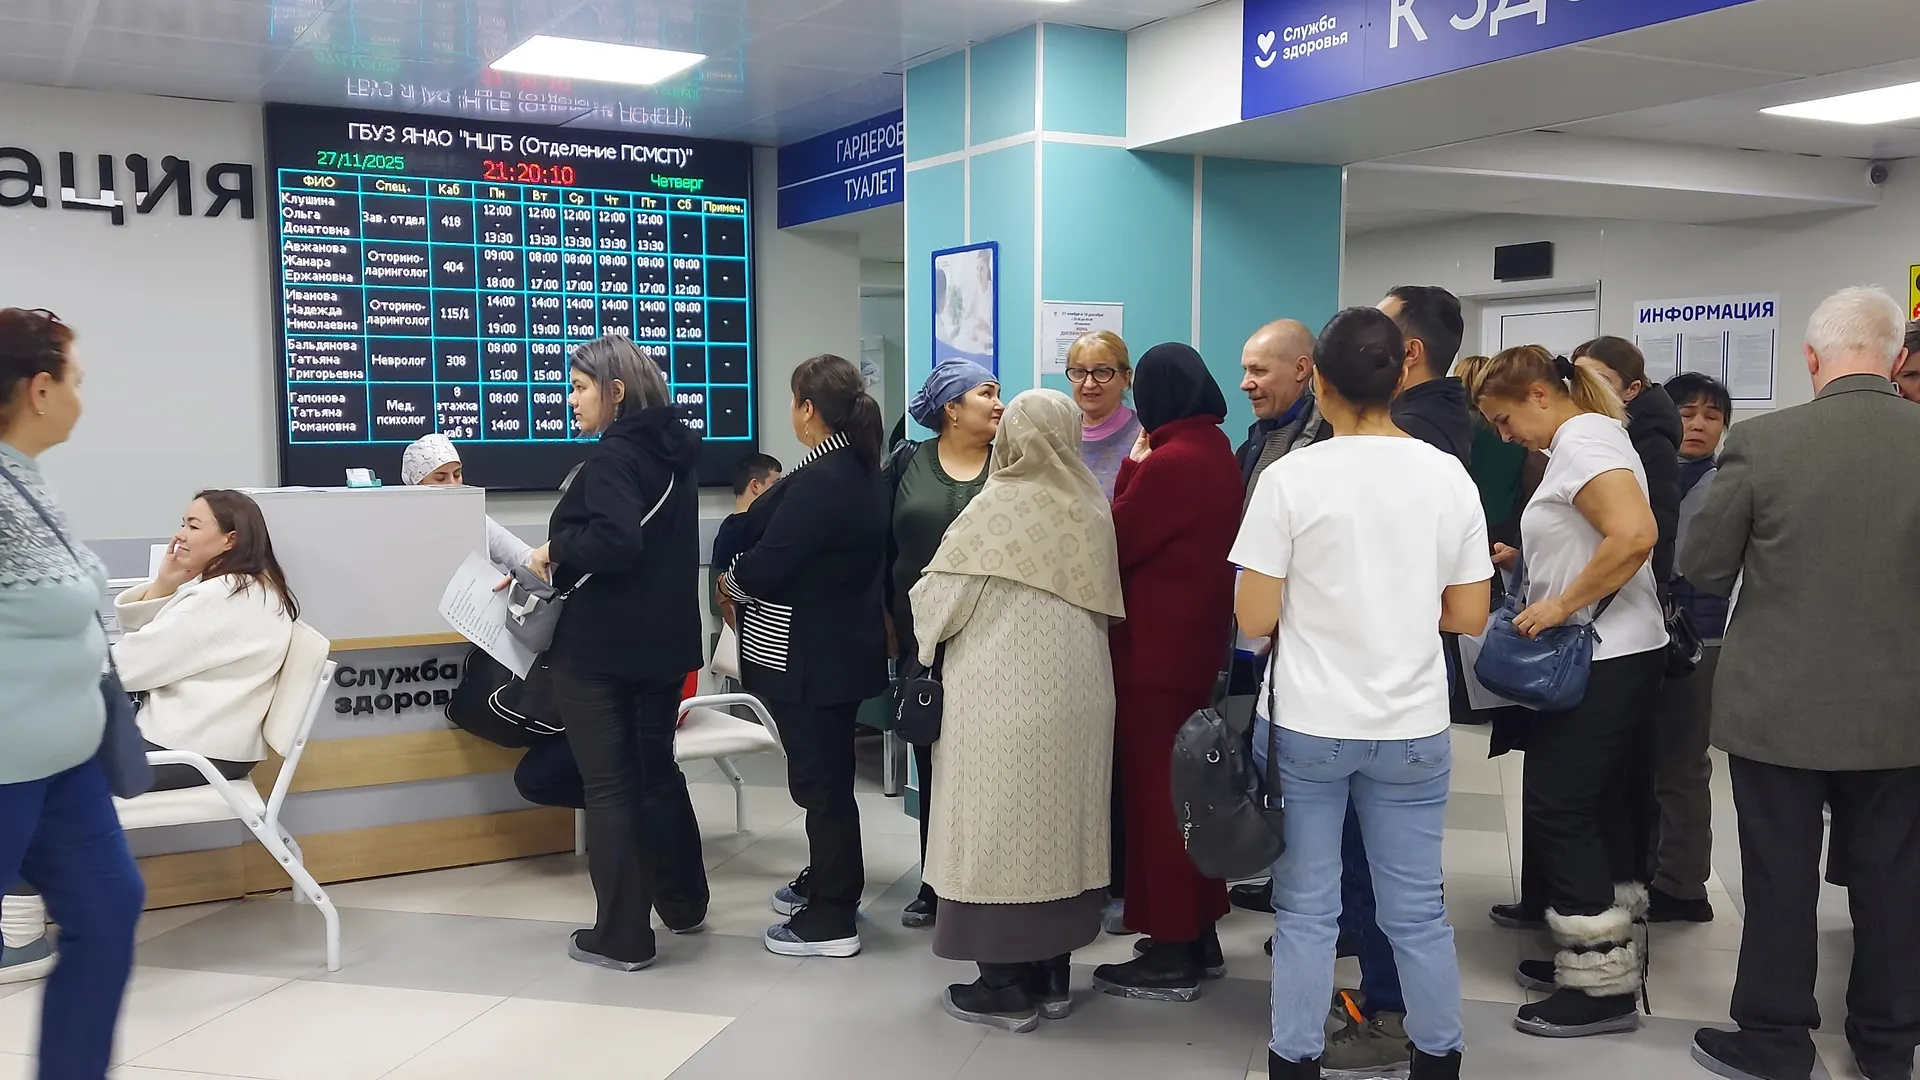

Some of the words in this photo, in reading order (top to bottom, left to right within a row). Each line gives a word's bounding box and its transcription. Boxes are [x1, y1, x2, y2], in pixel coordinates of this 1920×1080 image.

[1283, 14, 1336, 42] Служба
[1282, 31, 1348, 60] здоровья
[348, 122, 396, 143] ГБУЗ
[401, 127, 453, 147] ЯНАО
[459, 128, 514, 152] "НЦГБ
[519, 135, 617, 161] (Отделение
[621, 145, 694, 168] ПСМСП)"
[836, 120, 904, 163] ГАРДЕРОБ
[316, 150, 405, 171] 27/11/2025
[482, 160, 575, 185] 21:20:10
[302, 175, 336, 188] ФИО
[375, 180, 411, 194] Спец.
[650, 173, 704, 192] Четверг
[844, 167, 897, 202] ТУАЛЕТ
[438, 183, 460, 195] Каб
[489, 187, 506, 199] Пн
[281, 192, 336, 207] Клушина
[532, 190, 548, 202] Вт
[569, 193, 584, 205] Ср
[604, 195, 619, 206] Чт
[641, 197, 657, 208] Пт
[677, 199, 692, 210] Сб
[704, 201, 744, 214] Примеч.
[282, 207, 321, 221] Ольга
[483, 204, 513, 217] 12:00
[528, 207, 556, 219] 12:00
[563, 209, 591, 222] 12:00
[390, 215, 426, 226] отдел
[441, 216, 461, 228] 418
[599, 211, 626, 223] 12:00
[637, 213, 664, 226] 12:00
[283, 222, 350, 236] Донатовна
[484, 231, 514, 244] 13:30
[529, 234, 557, 246] 13:30
[564, 236, 592, 248] 13:30
[283, 240, 347, 254] Авжанова
[599, 238, 627, 250] 13:30
[637, 240, 664, 251] 13:30
[282, 254, 331, 268] Жанара
[367, 250, 424, 264] Оторино-
[484, 249, 514, 261] 09:00
[529, 251, 557, 264] 08:00
[564, 253, 592, 266] 08:00
[599, 255, 627, 267] 08:00
[442, 261, 464, 273] 404
[637, 257, 665, 269] 08:00
[673, 258, 700, 270] 08:00
[284, 269, 354, 283] Ержановна
[365, 266, 428, 278] ларинголог
[486, 277, 515, 289] 18:00
[530, 278, 559, 291] 17:00
[565, 280, 593, 292] 17:00
[601, 281, 628, 293] 17:00
[639, 283, 665, 294] 17:00
[285, 289, 338, 302] Иванова
[674, 284, 701, 296] 12:00
[369, 299, 426, 312] Оторино-
[487, 295, 516, 308] 14:00
[531, 296, 559, 309] 14:00
[566, 298, 594, 310] 14:00
[601, 299, 628, 311] 14:00
[639, 301, 666, 313] 14:00
[674, 302, 701, 313] 08:00
[286, 303, 343, 317] Надежда
[440, 307, 470, 321] 115/1
[1639, 301, 1774, 324] ИНФОРМАЦИЯ
[287, 318, 358, 331] Николаевна
[367, 315, 430, 327] ларинголог
[487, 322, 516, 335] 19:00
[532, 323, 560, 336] 19:00
[567, 324, 594, 336] 19:00
[602, 325, 629, 337] 19:00
[640, 326, 666, 338] 19:00
[676, 327, 702, 339] 12:00
[287, 339, 357, 353] Бальдянова
[487, 342, 517, 354] 08:00
[531, 344, 561, 355] 08:00
[288, 353, 340, 366] Татьяна
[371, 354, 427, 368] Невролог
[445, 355, 466, 367] 308
[288, 368, 364, 381] Григорьевна
[489, 369, 518, 381] 15:00
[533, 369, 562, 381] 15:00
[453, 386, 461, 397] 8
[289, 392, 346, 405] Гапонова
[489, 392, 519, 404] 08:00
[533, 392, 562, 404] 08:00
[676, 393, 703, 405] 08:00
[290, 406, 343, 418] Татьяна
[436, 401, 478, 412] этажка
[376, 415, 426, 427] психолог
[438, 414, 446, 425] 3
[448, 415, 479, 425] этаж
[491, 419, 519, 431] 14:00
[535, 419, 563, 431] 14:00
[679, 418, 704, 429] 2:00
[291, 421, 357, 433] Романовна
[443, 427, 463, 438] каб
[465, 427, 473, 438] 9
[334, 658, 458, 690] Служба
